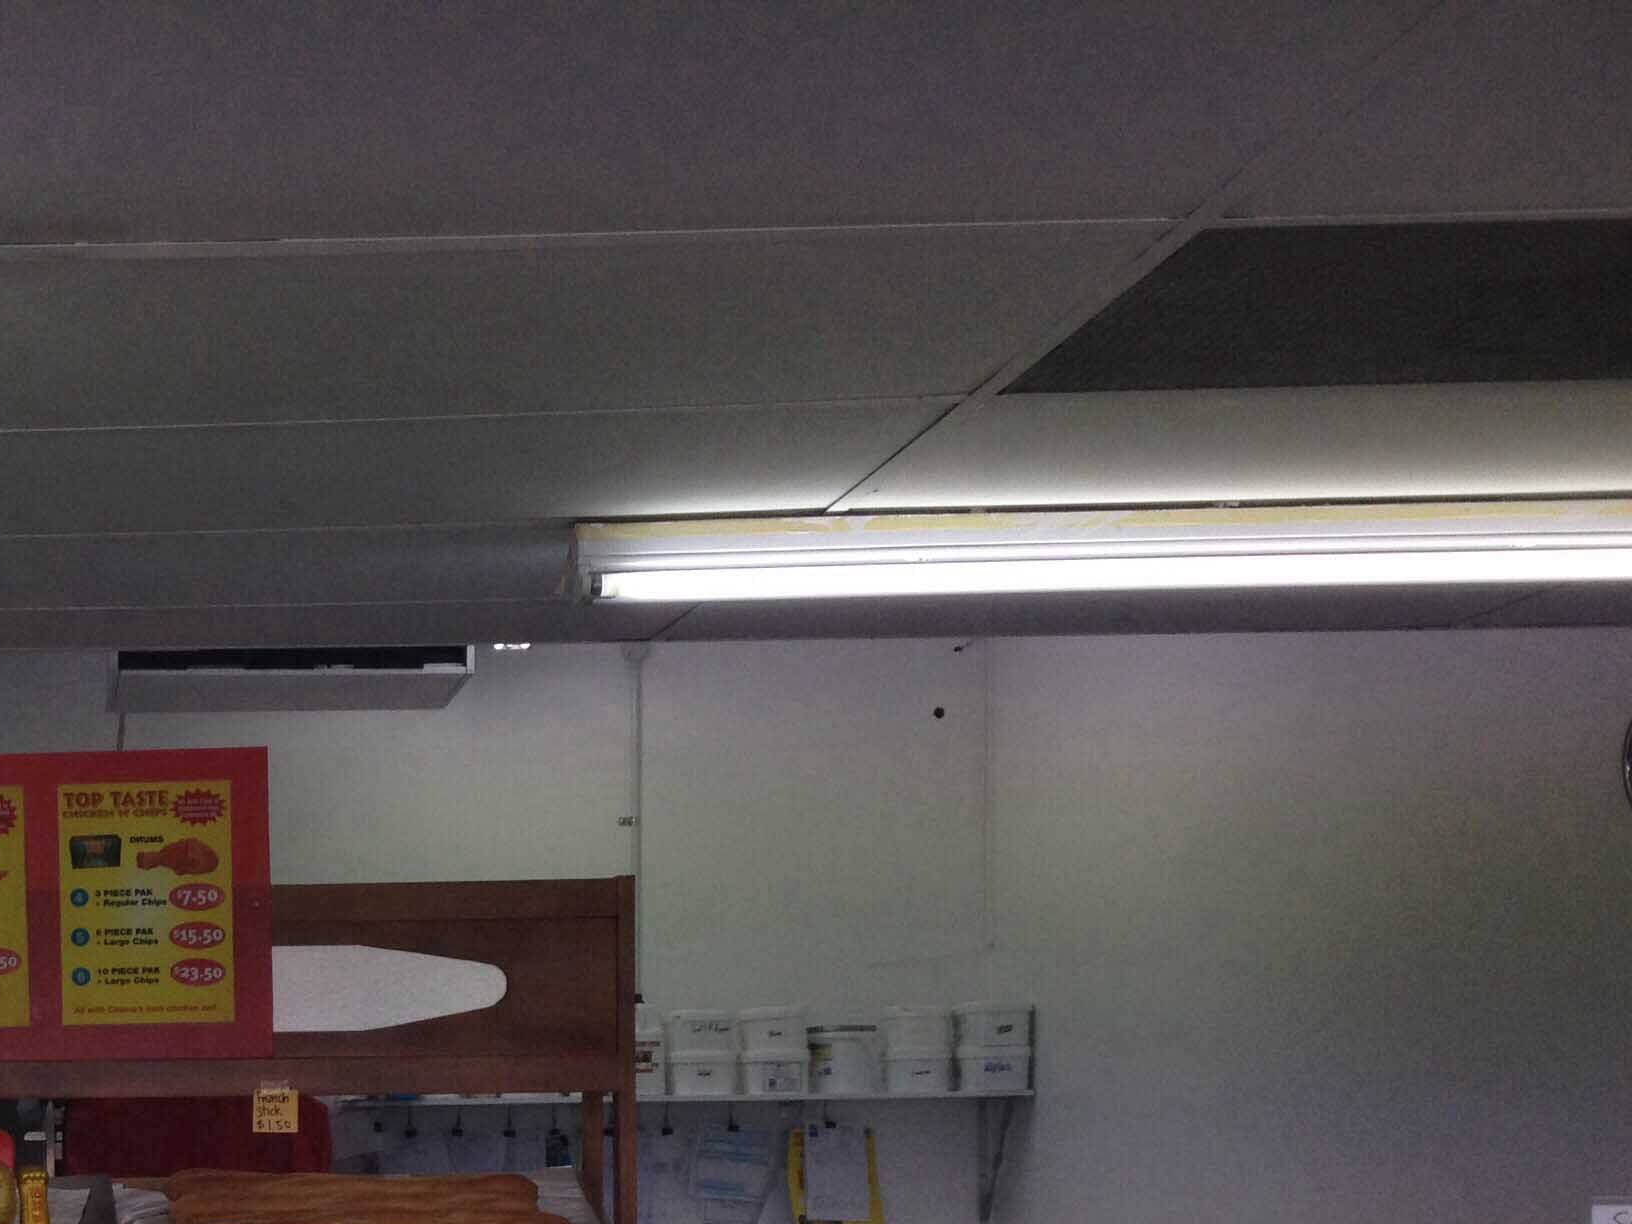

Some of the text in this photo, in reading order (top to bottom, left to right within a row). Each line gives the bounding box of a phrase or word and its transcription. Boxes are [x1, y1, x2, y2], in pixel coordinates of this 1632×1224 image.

[63, 791, 105, 809] TOP
[110, 789, 169, 808] TASTE
[129, 835, 164, 844] DRUMS
[103, 889, 132, 898] PIECE
[134, 888, 153, 897] PAK
[176, 889, 219, 906] $7.50
[103, 897, 168, 908] Regular Chips
[104, 928, 133, 937] PIECE
[135, 927, 154, 936] PAK
[173, 928, 224, 945] $15.50
[103, 937, 159, 948] Large Chips
[111, 967, 140, 976] PIECE
[174, 966, 224, 983] $23.50
[104, 976, 160, 987] Large Chips
